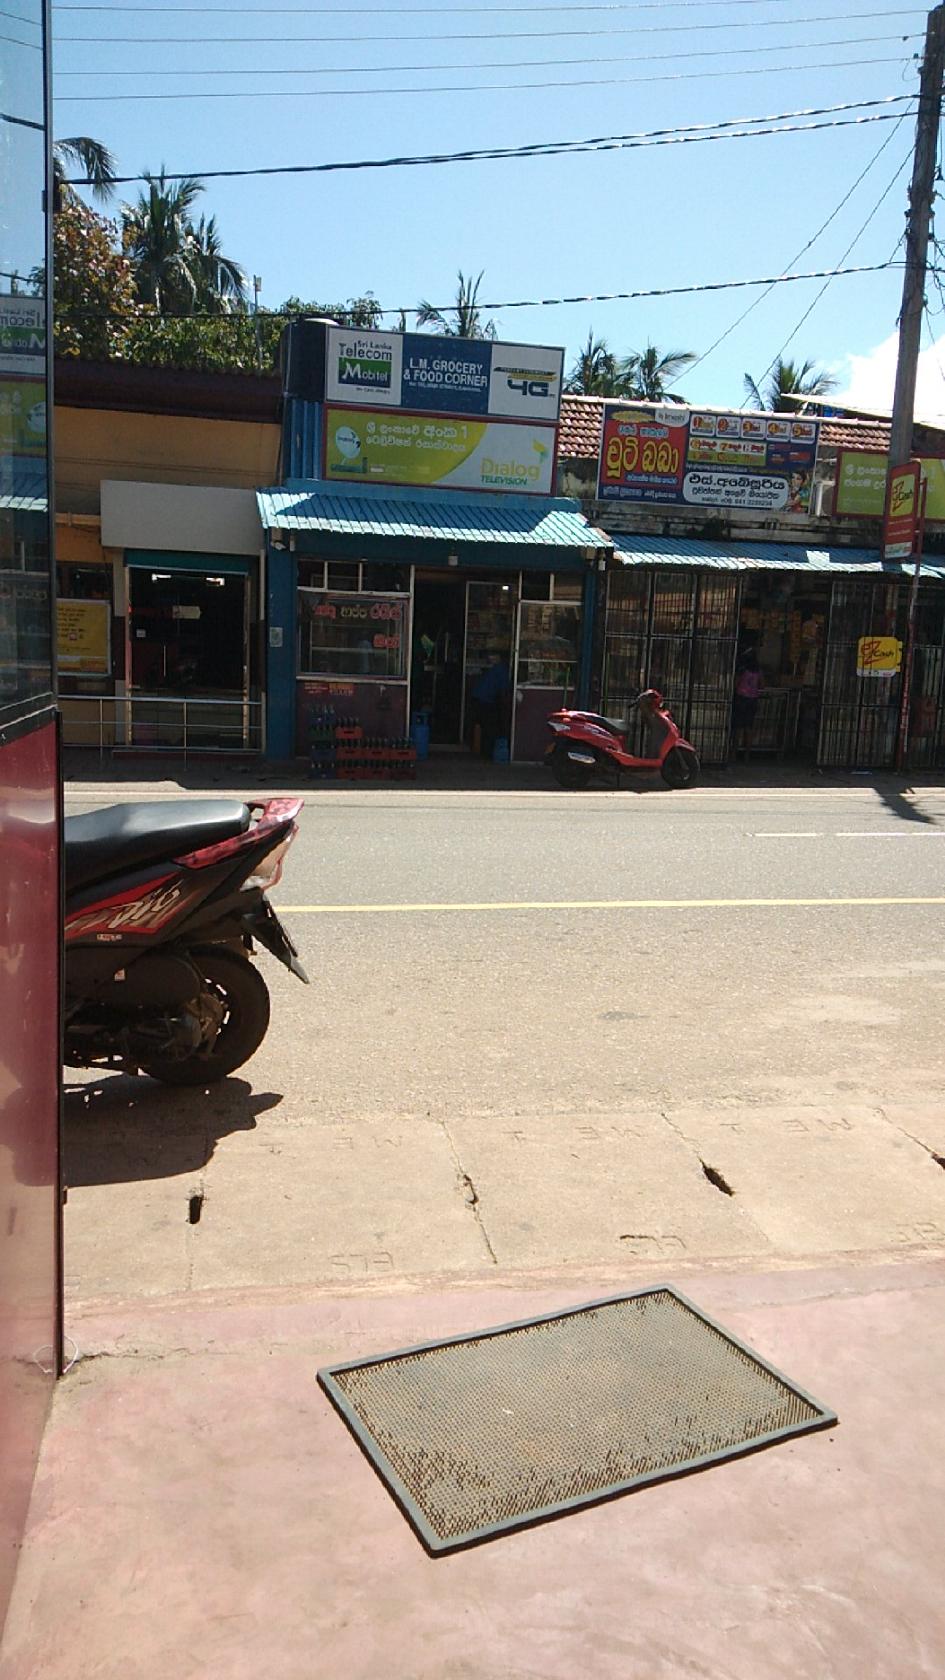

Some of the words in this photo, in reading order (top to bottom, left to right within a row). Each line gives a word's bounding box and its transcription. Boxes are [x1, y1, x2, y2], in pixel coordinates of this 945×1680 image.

[338, 343, 392, 361] Telecom
[432, 359, 484, 375] GROCERY
[403, 368, 411, 381] &
[413, 369, 443, 383] FOOD
[444, 372, 488, 388] CORNER
[481, 457, 541, 481] Dialog
[481, 474, 528, 486] TELEVISION
